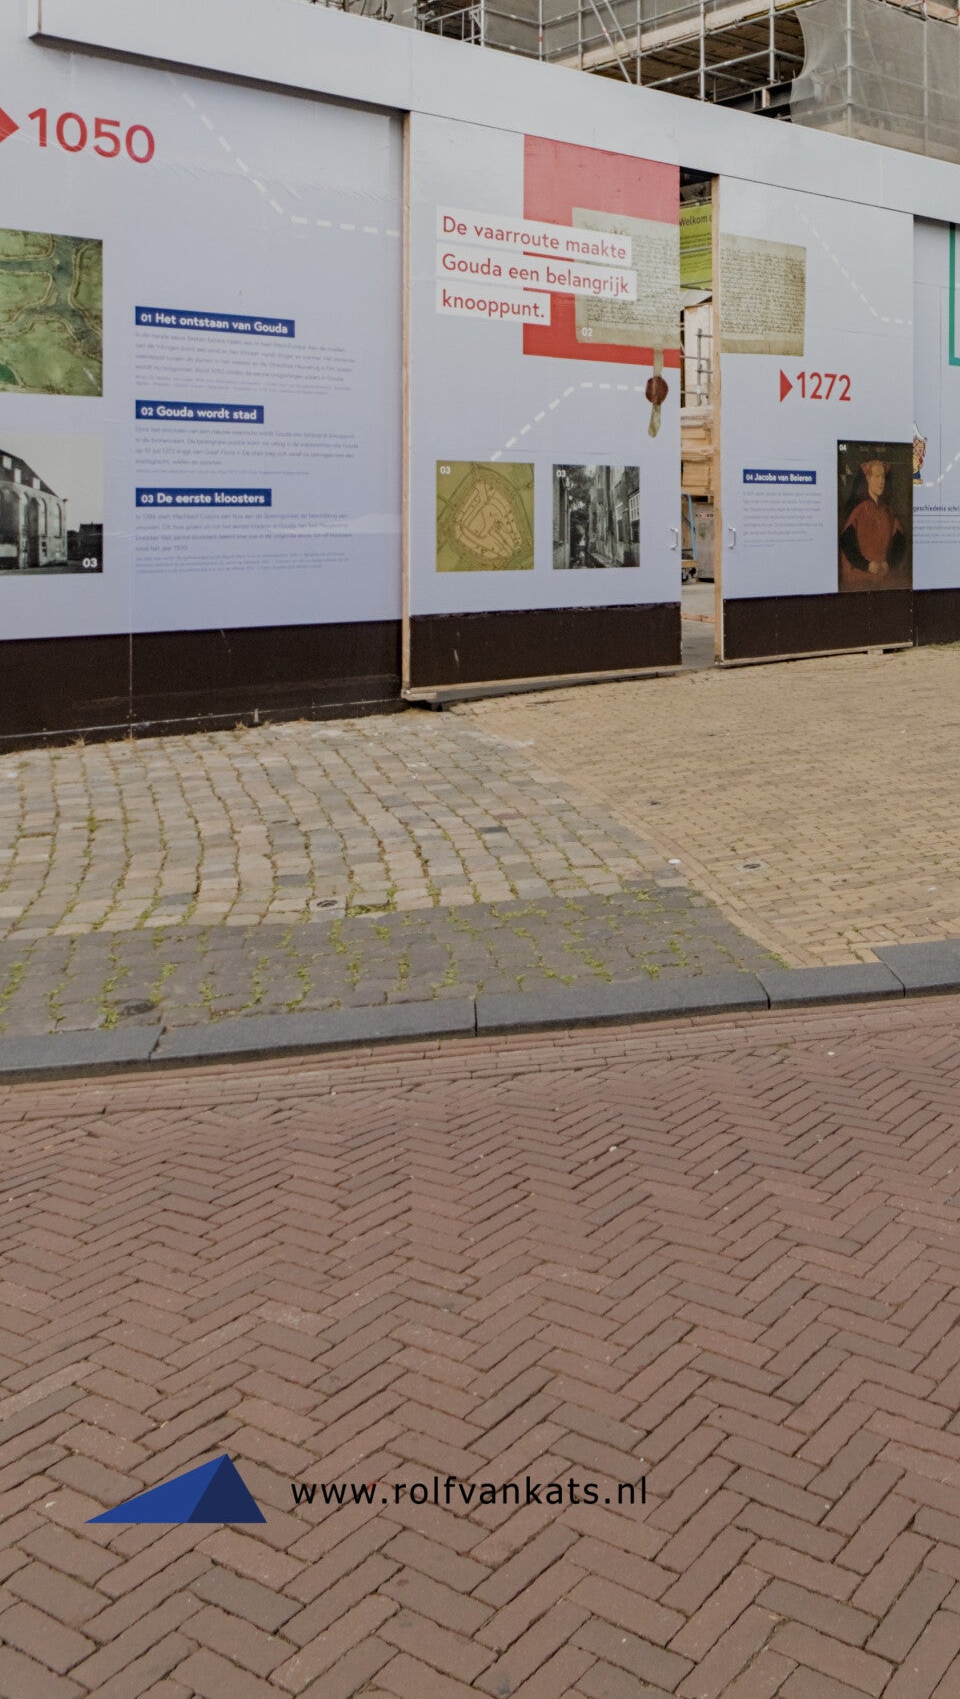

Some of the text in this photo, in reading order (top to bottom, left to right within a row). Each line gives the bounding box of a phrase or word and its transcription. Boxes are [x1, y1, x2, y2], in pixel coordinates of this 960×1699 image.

[28, 107, 156, 164] 1050
[443, 216, 626, 259] De vaarroute maakte
[442, 253, 629, 296] Gouda een belangrijk
[442, 289, 545, 319] knooppunt.
[140, 313, 288, 334] 01 Het ontstaan van Gouda
[581, 327, 593, 337] 02
[796, 371, 851, 401] 1272
[140, 406, 257, 420] 02 Gouda wordt stad
[440, 466, 451, 475] 03
[556, 470, 566, 478] 03
[754, 473, 777, 481] Jacoba
[141, 493, 265, 504] 03 De eerste kloosters
[82, 558, 98, 568] 03
